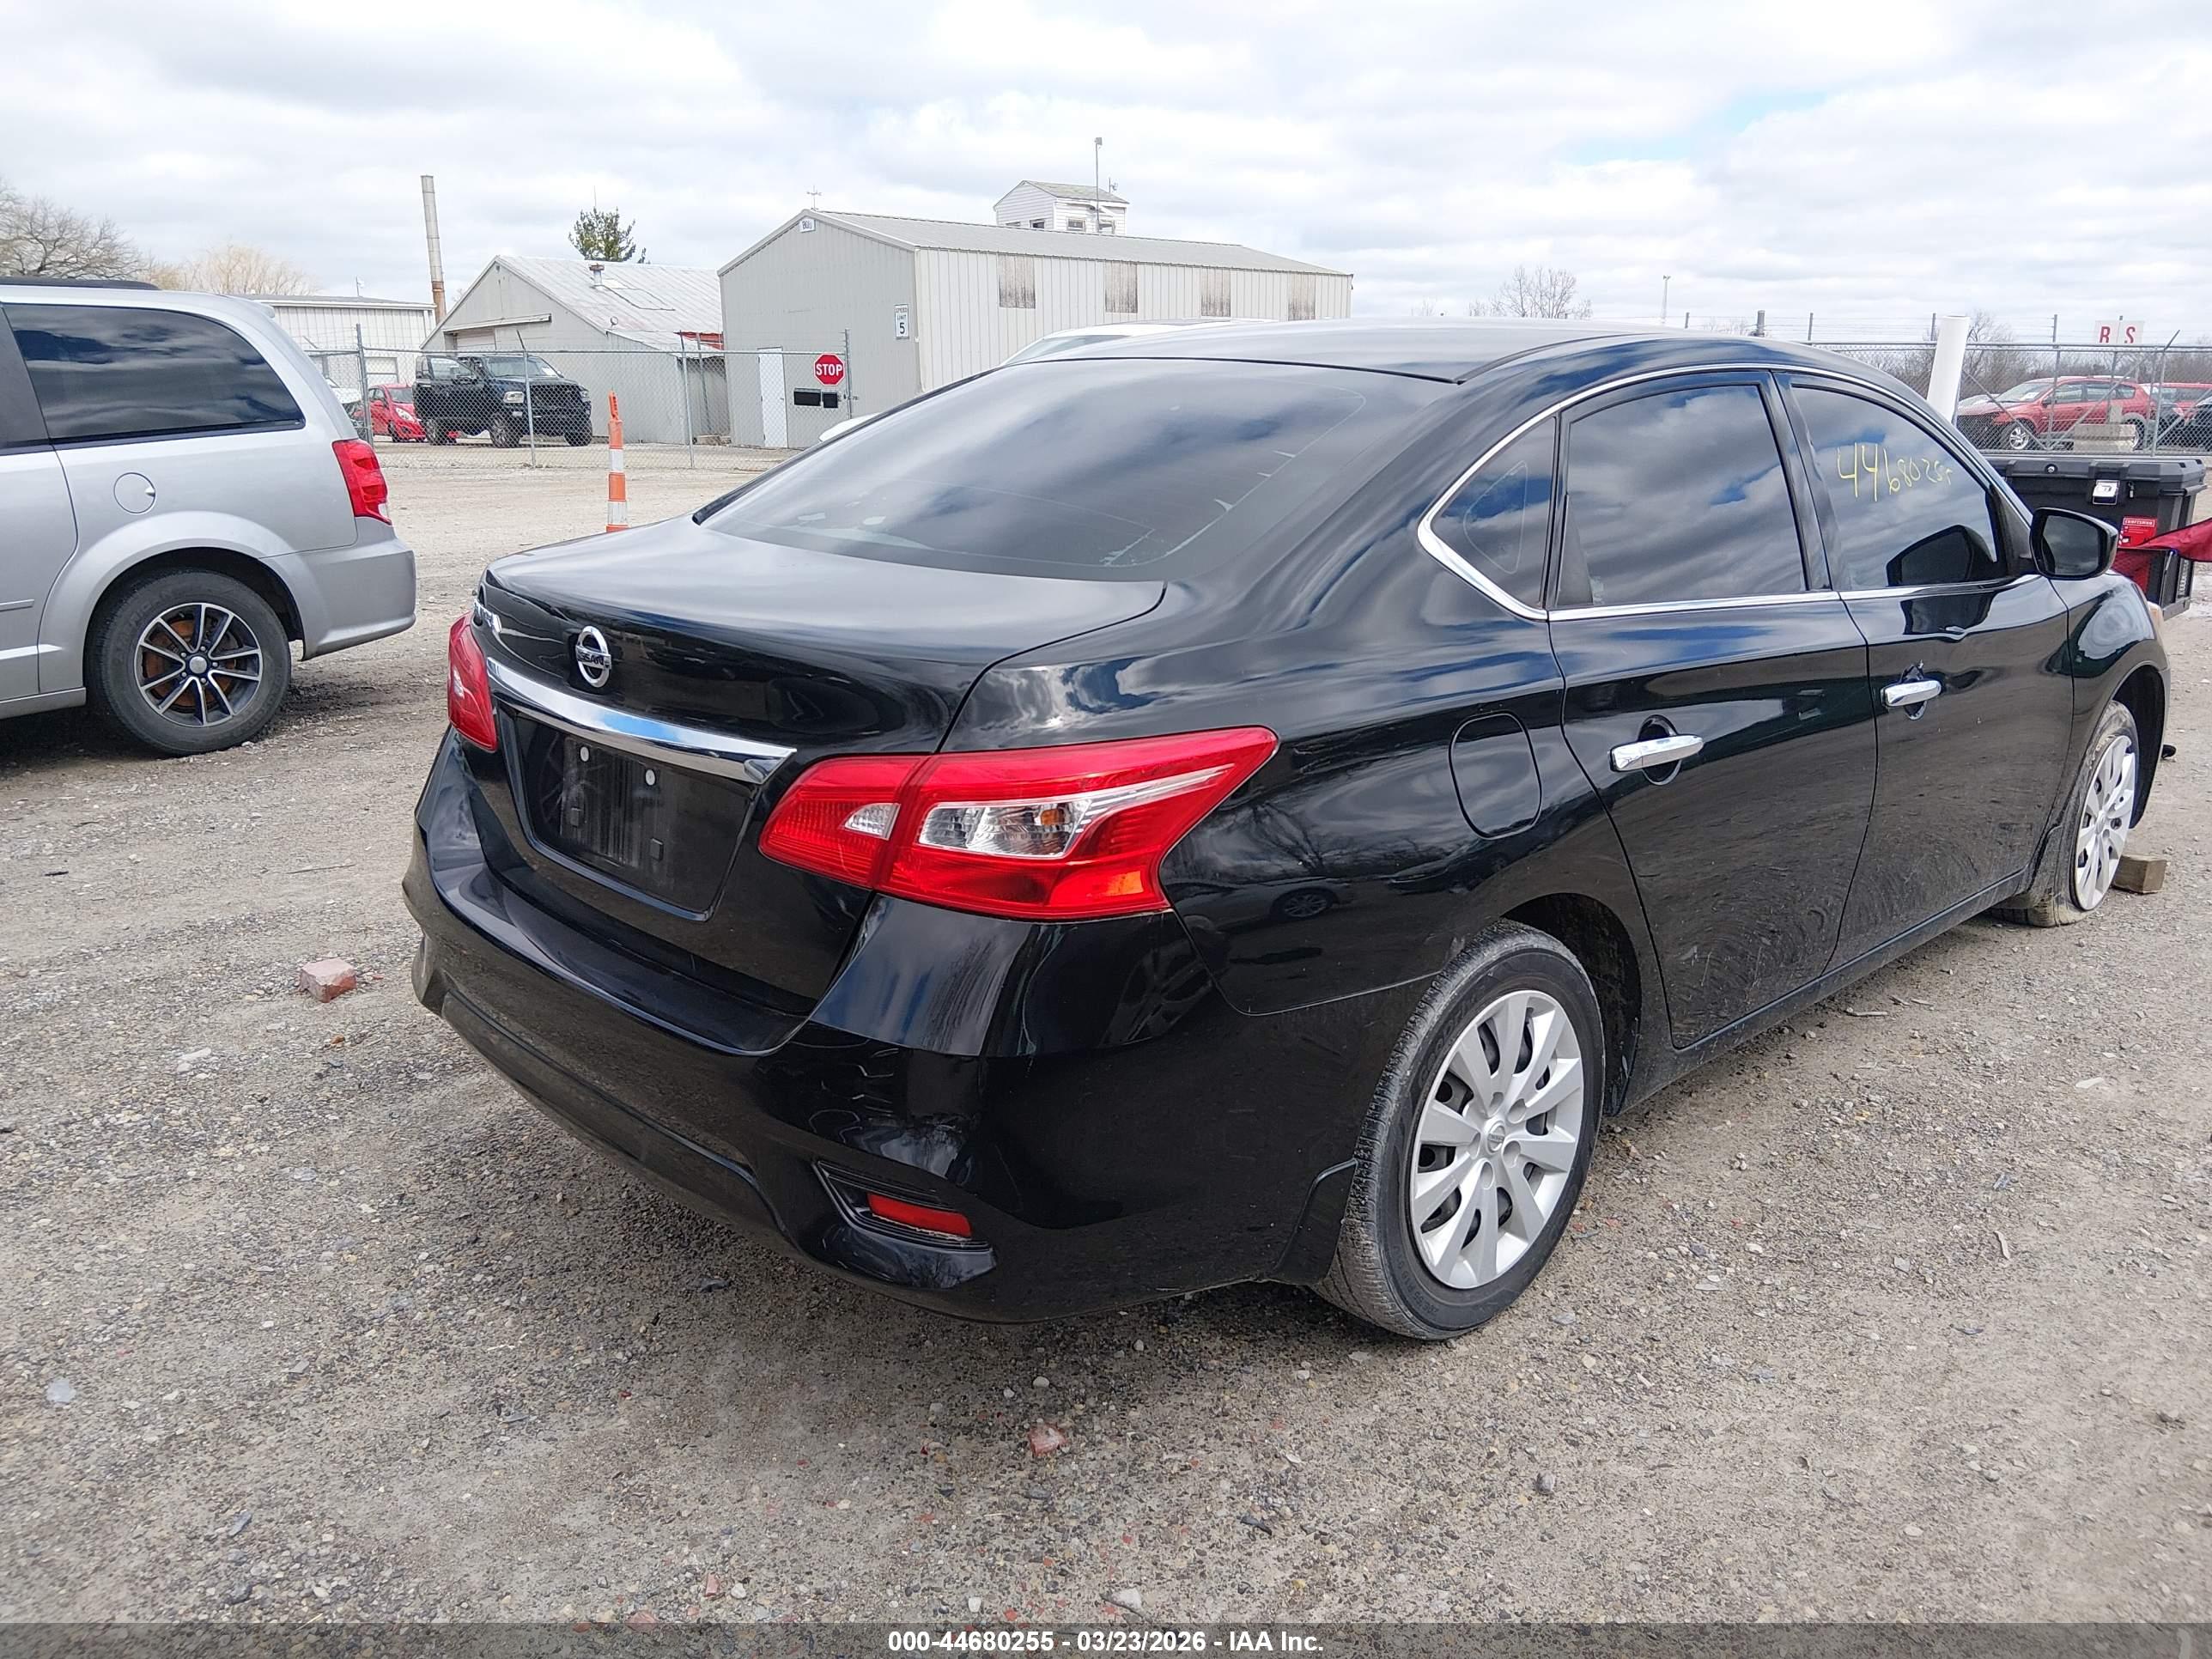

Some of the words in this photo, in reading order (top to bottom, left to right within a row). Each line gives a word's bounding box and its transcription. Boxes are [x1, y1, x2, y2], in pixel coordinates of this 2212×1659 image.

[899, 322, 906, 334] 5
[2100, 326, 2111, 343] R
[2124, 326, 2136, 343] S
[816, 363, 842, 376] STOP
